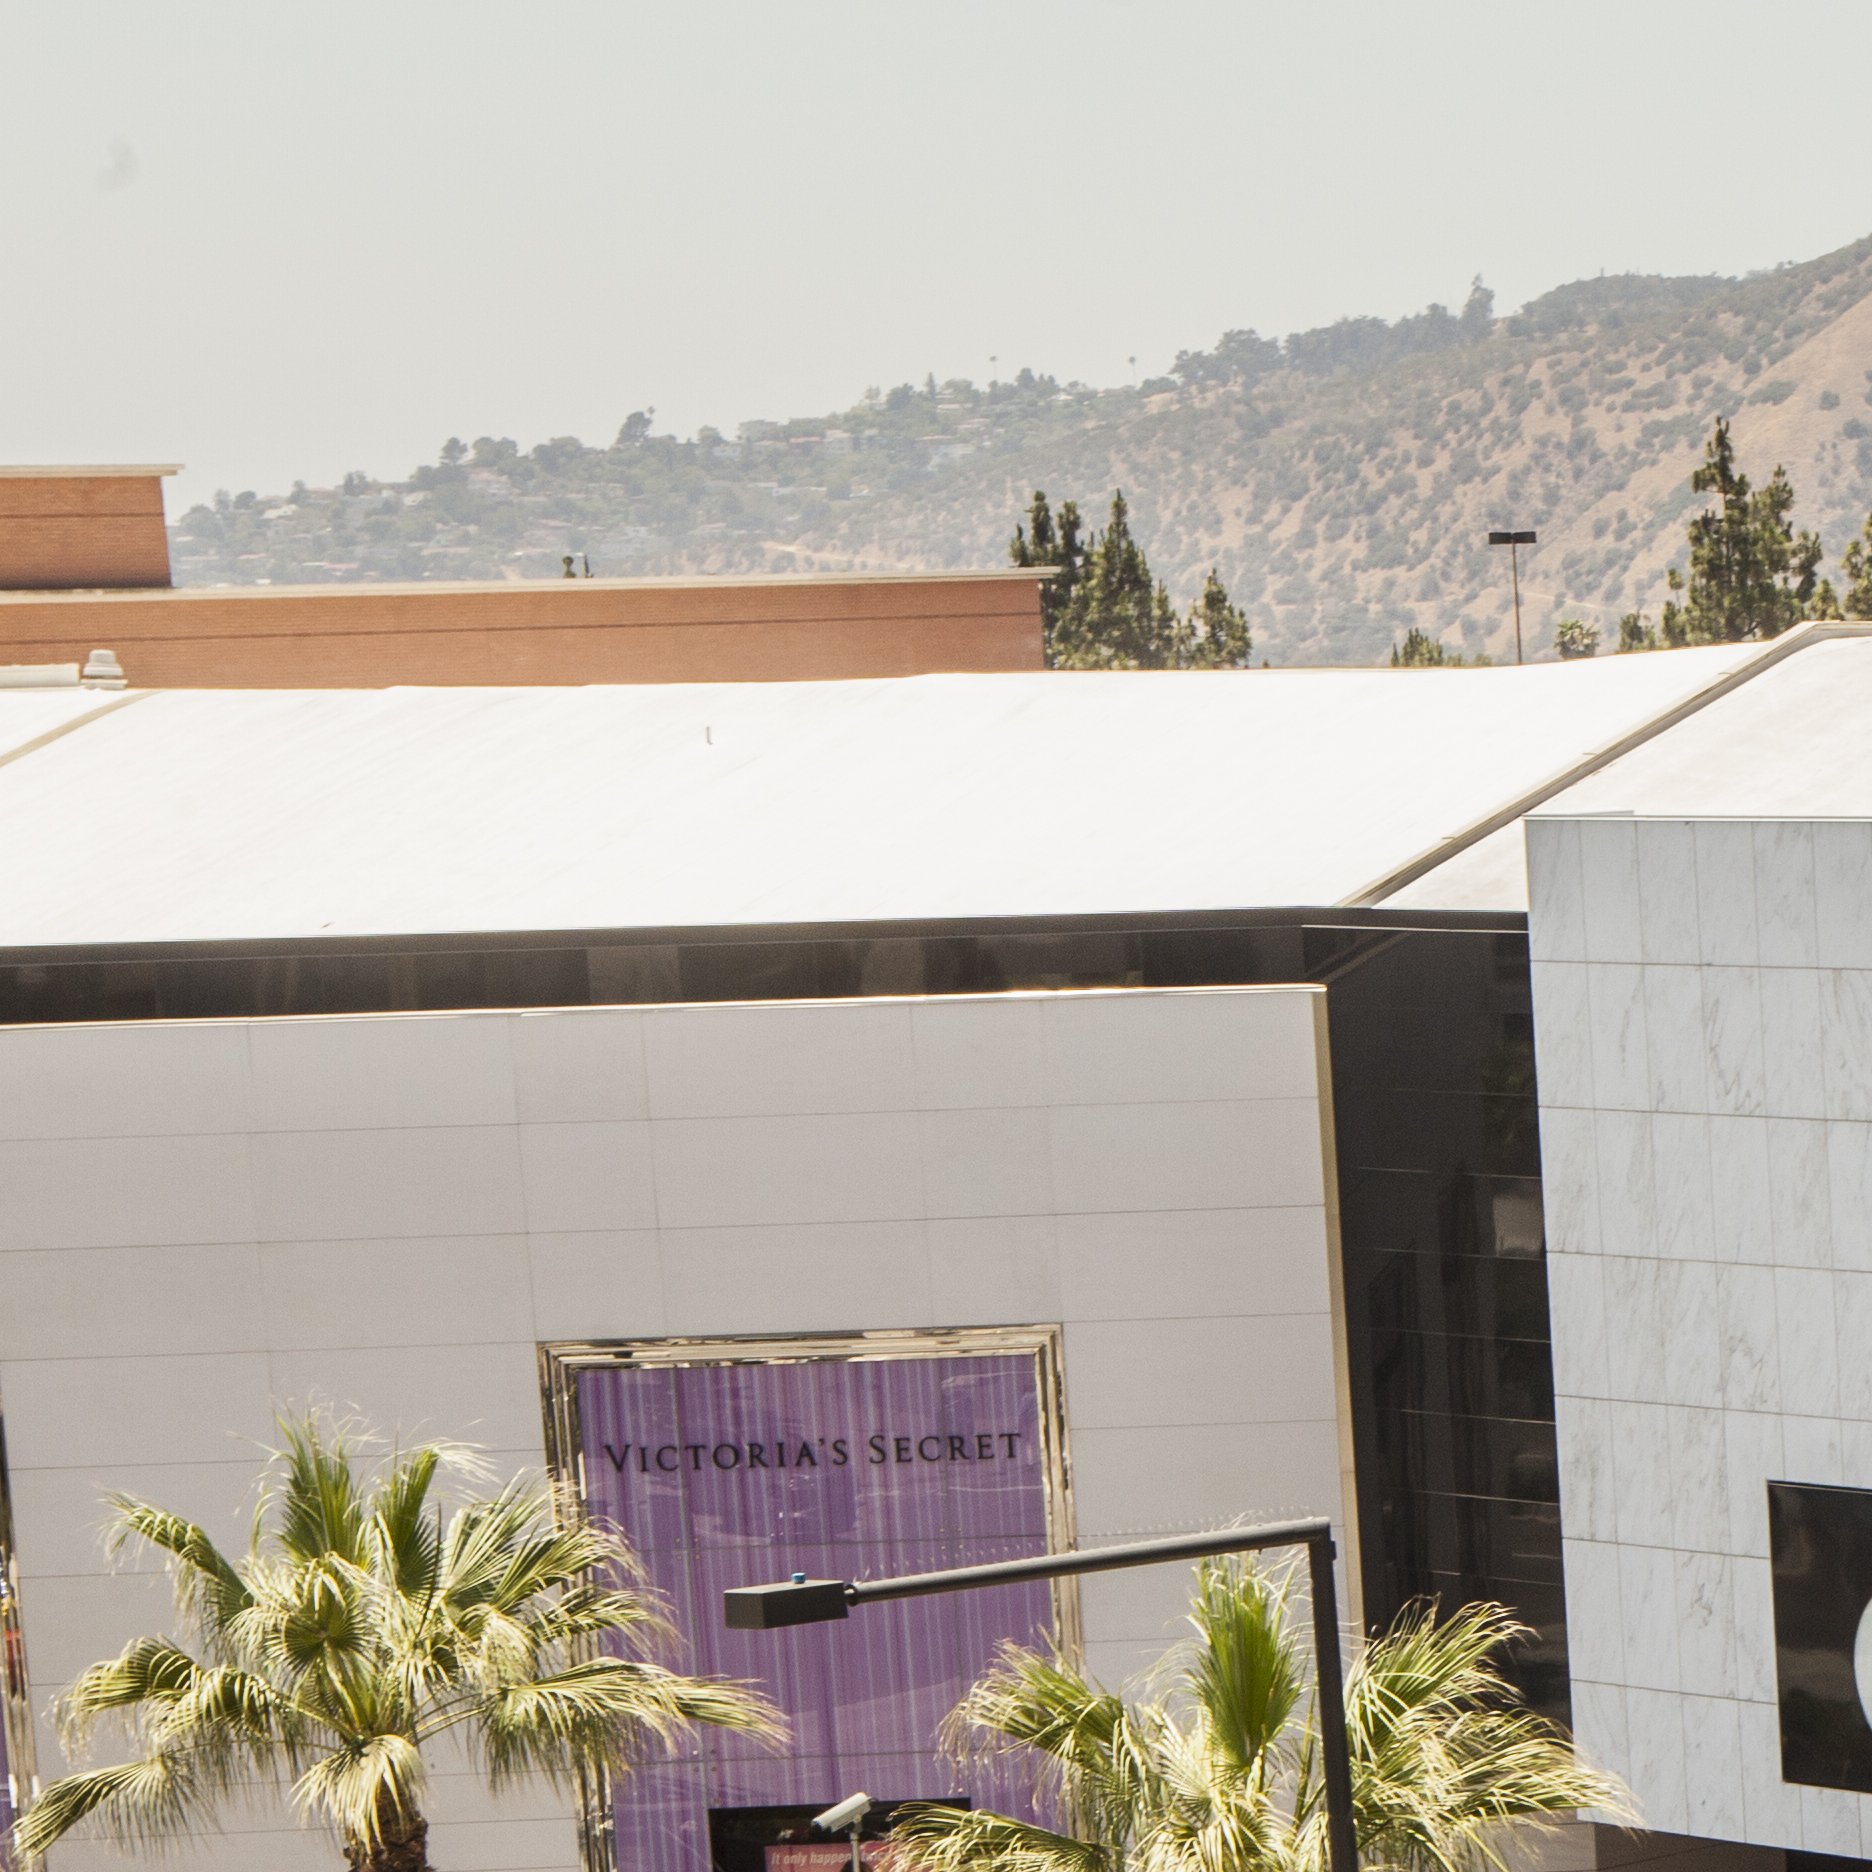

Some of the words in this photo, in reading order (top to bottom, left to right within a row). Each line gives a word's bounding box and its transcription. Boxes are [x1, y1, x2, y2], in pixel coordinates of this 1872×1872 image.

[604, 1438, 849, 1473] VICTORIA'S
[869, 1433, 1021, 1465] SECRET
[784, 1853, 807, 1867] only
